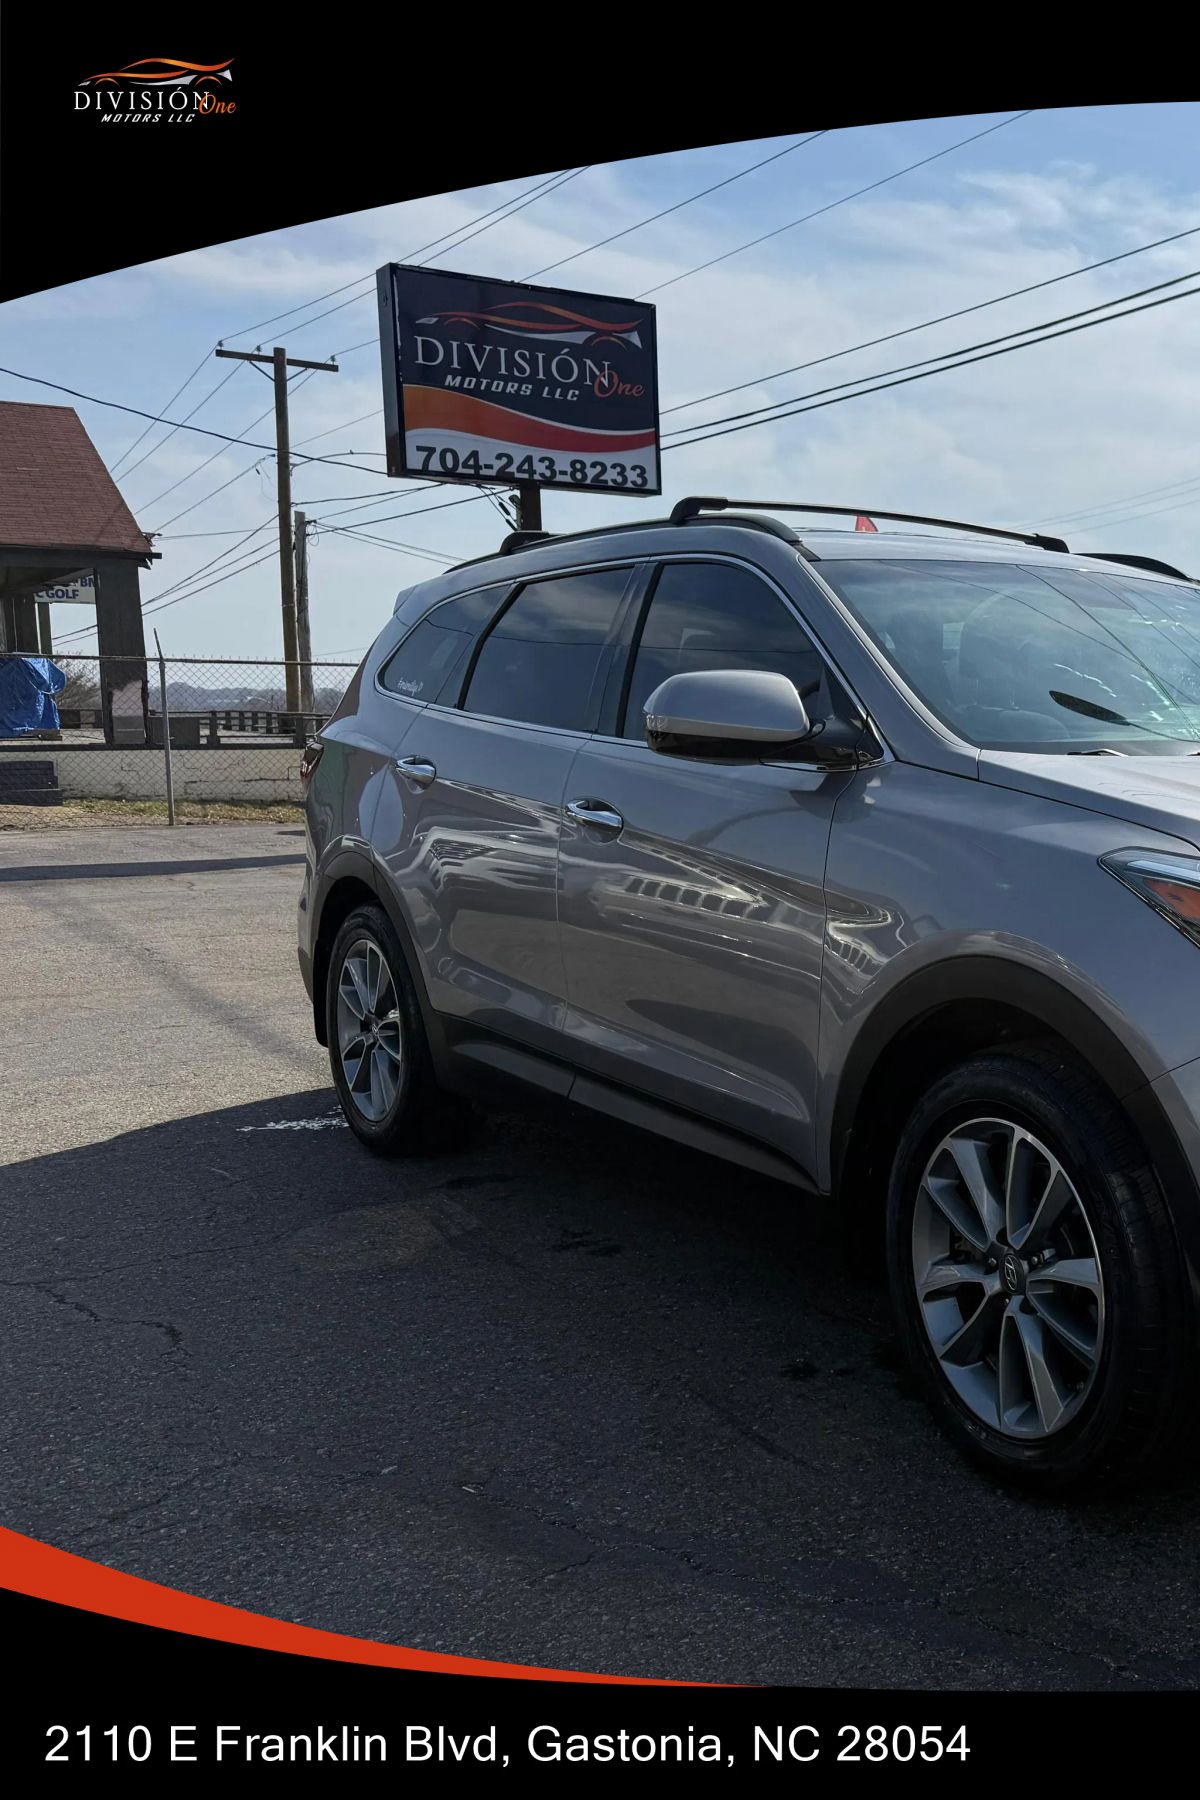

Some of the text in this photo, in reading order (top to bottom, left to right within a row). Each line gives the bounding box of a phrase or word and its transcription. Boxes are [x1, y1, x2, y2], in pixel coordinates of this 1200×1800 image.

[414, 335, 645, 398] DIVISIÓN One
[444, 374, 580, 401] MOTORS LLC
[416, 445, 649, 488] 704-243-8233
[46, 589, 79, 600] GOLF
